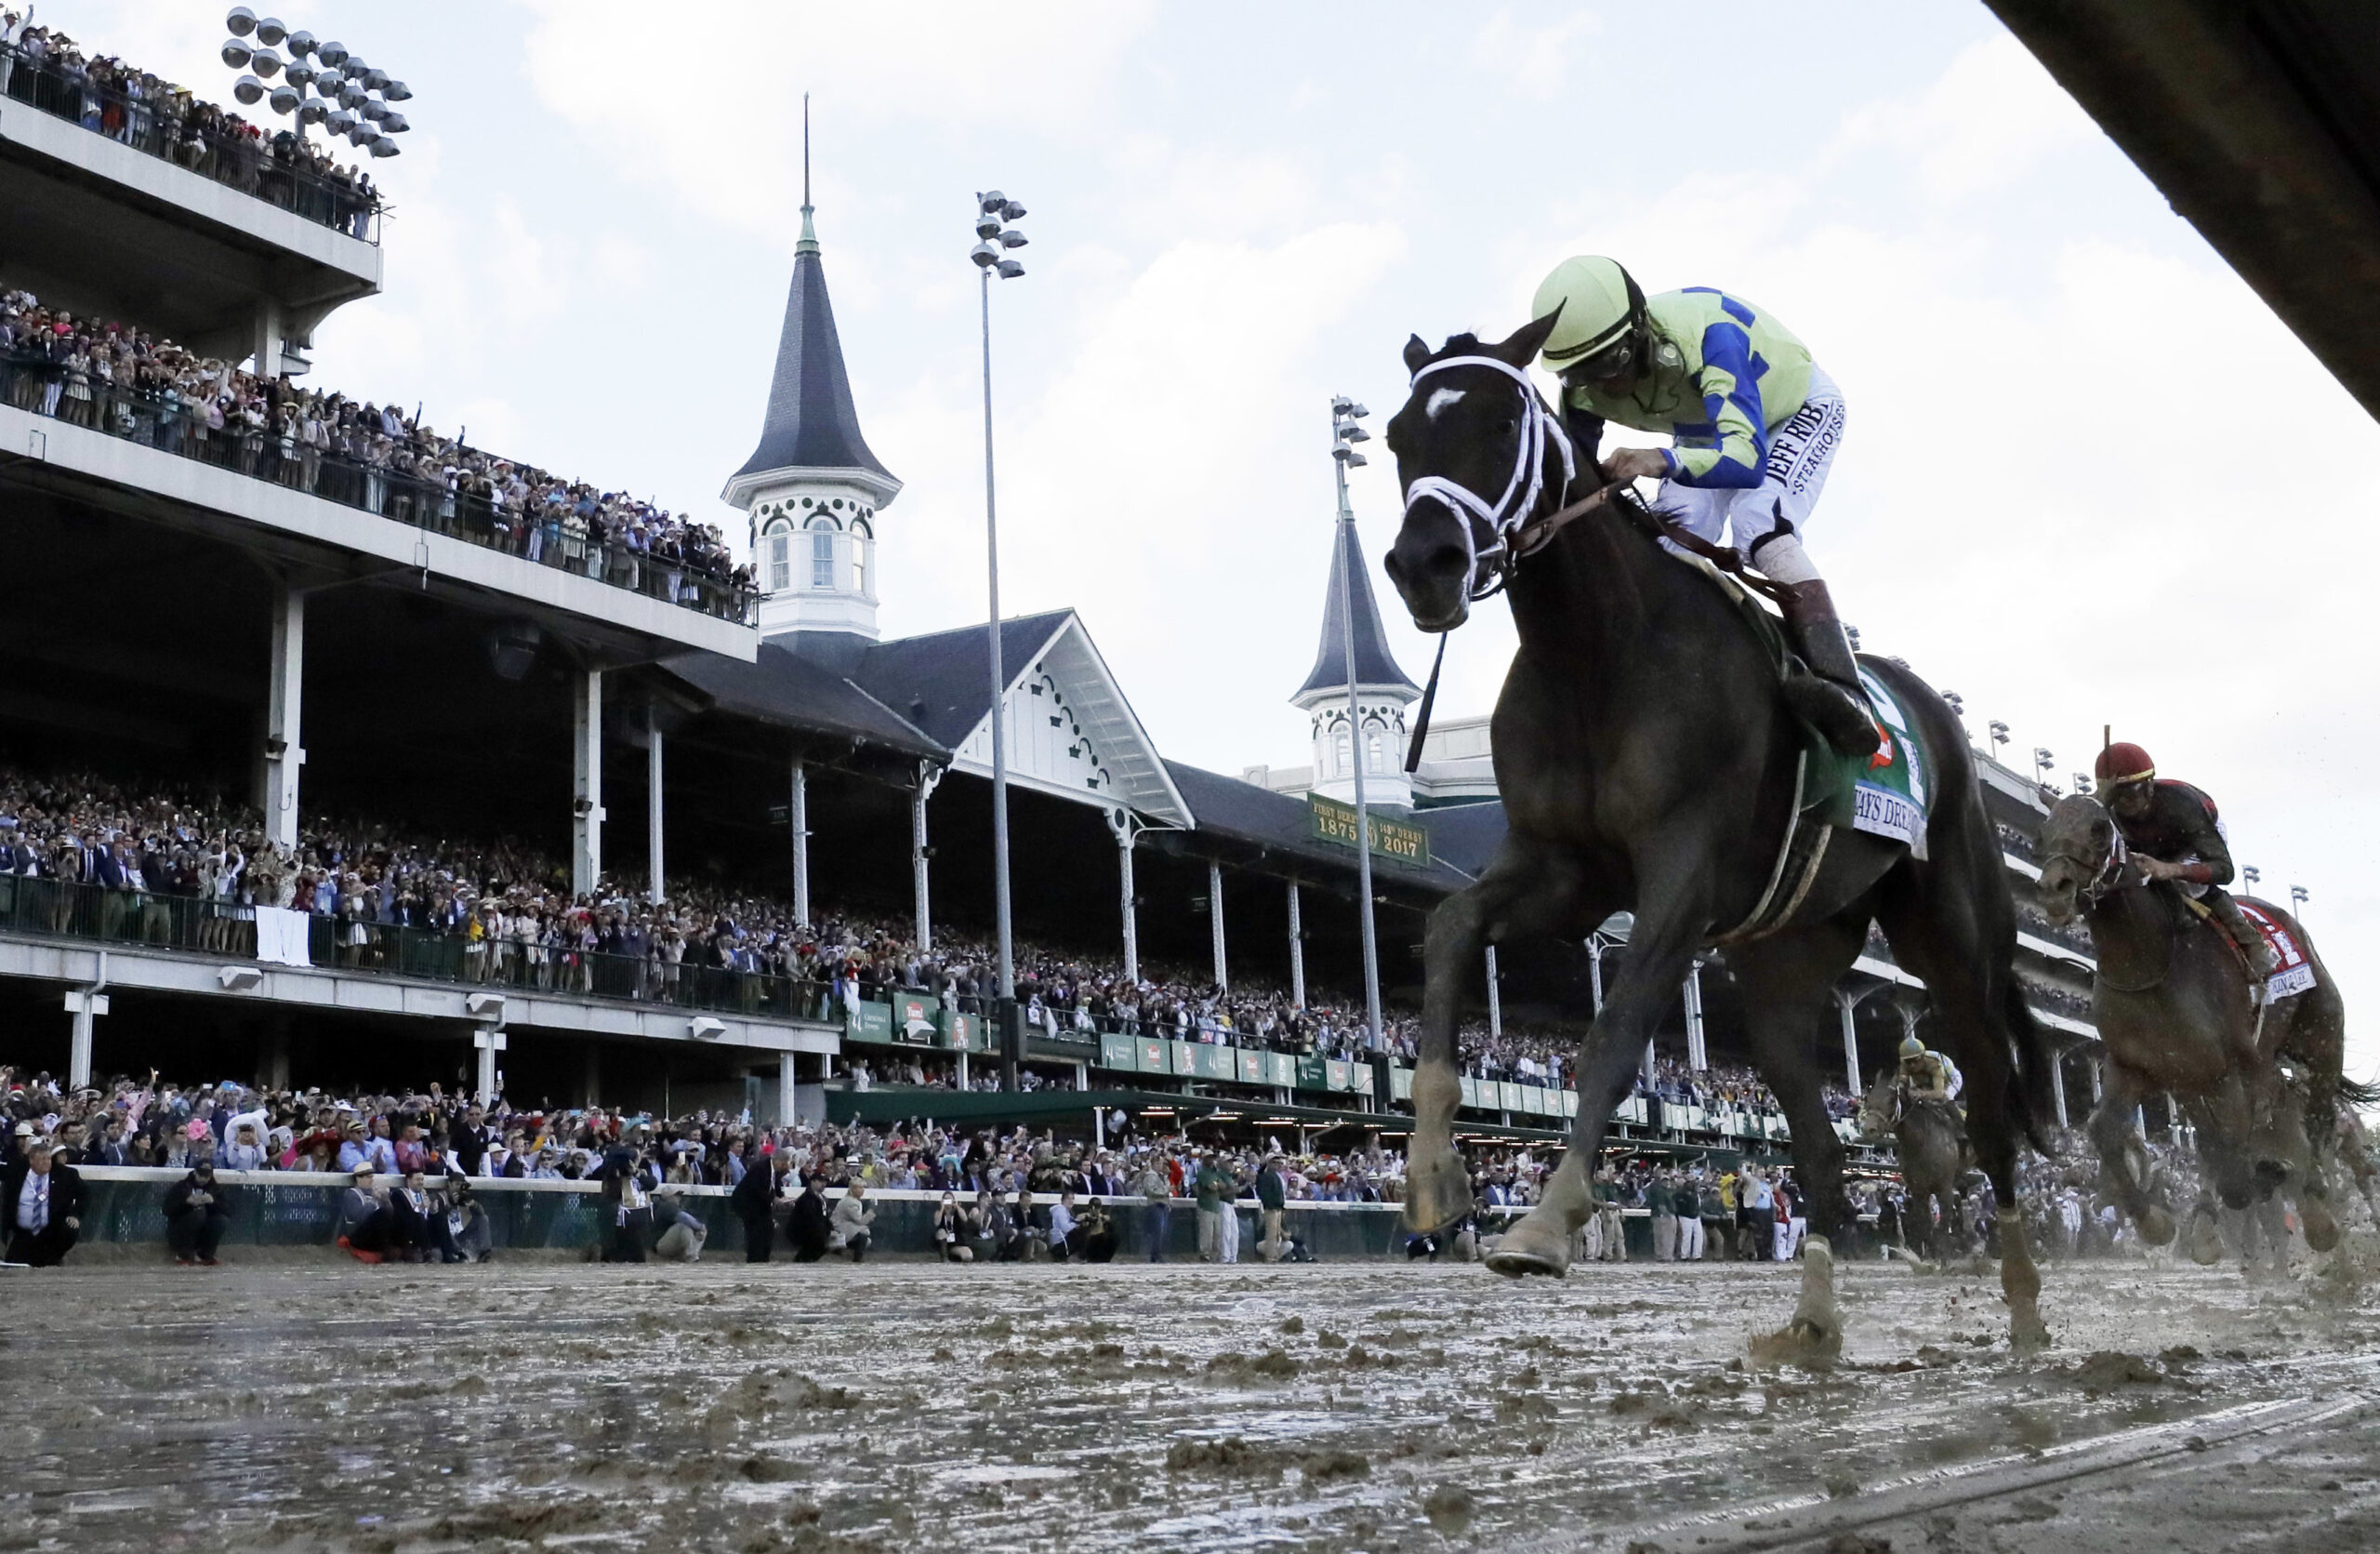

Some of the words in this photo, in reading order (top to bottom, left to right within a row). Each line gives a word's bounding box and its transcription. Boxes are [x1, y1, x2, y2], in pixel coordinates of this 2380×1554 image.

[1765, 439, 1799, 488] JEFF
[1319, 817, 1357, 842] 1875
[1383, 835, 1417, 857] 2017
